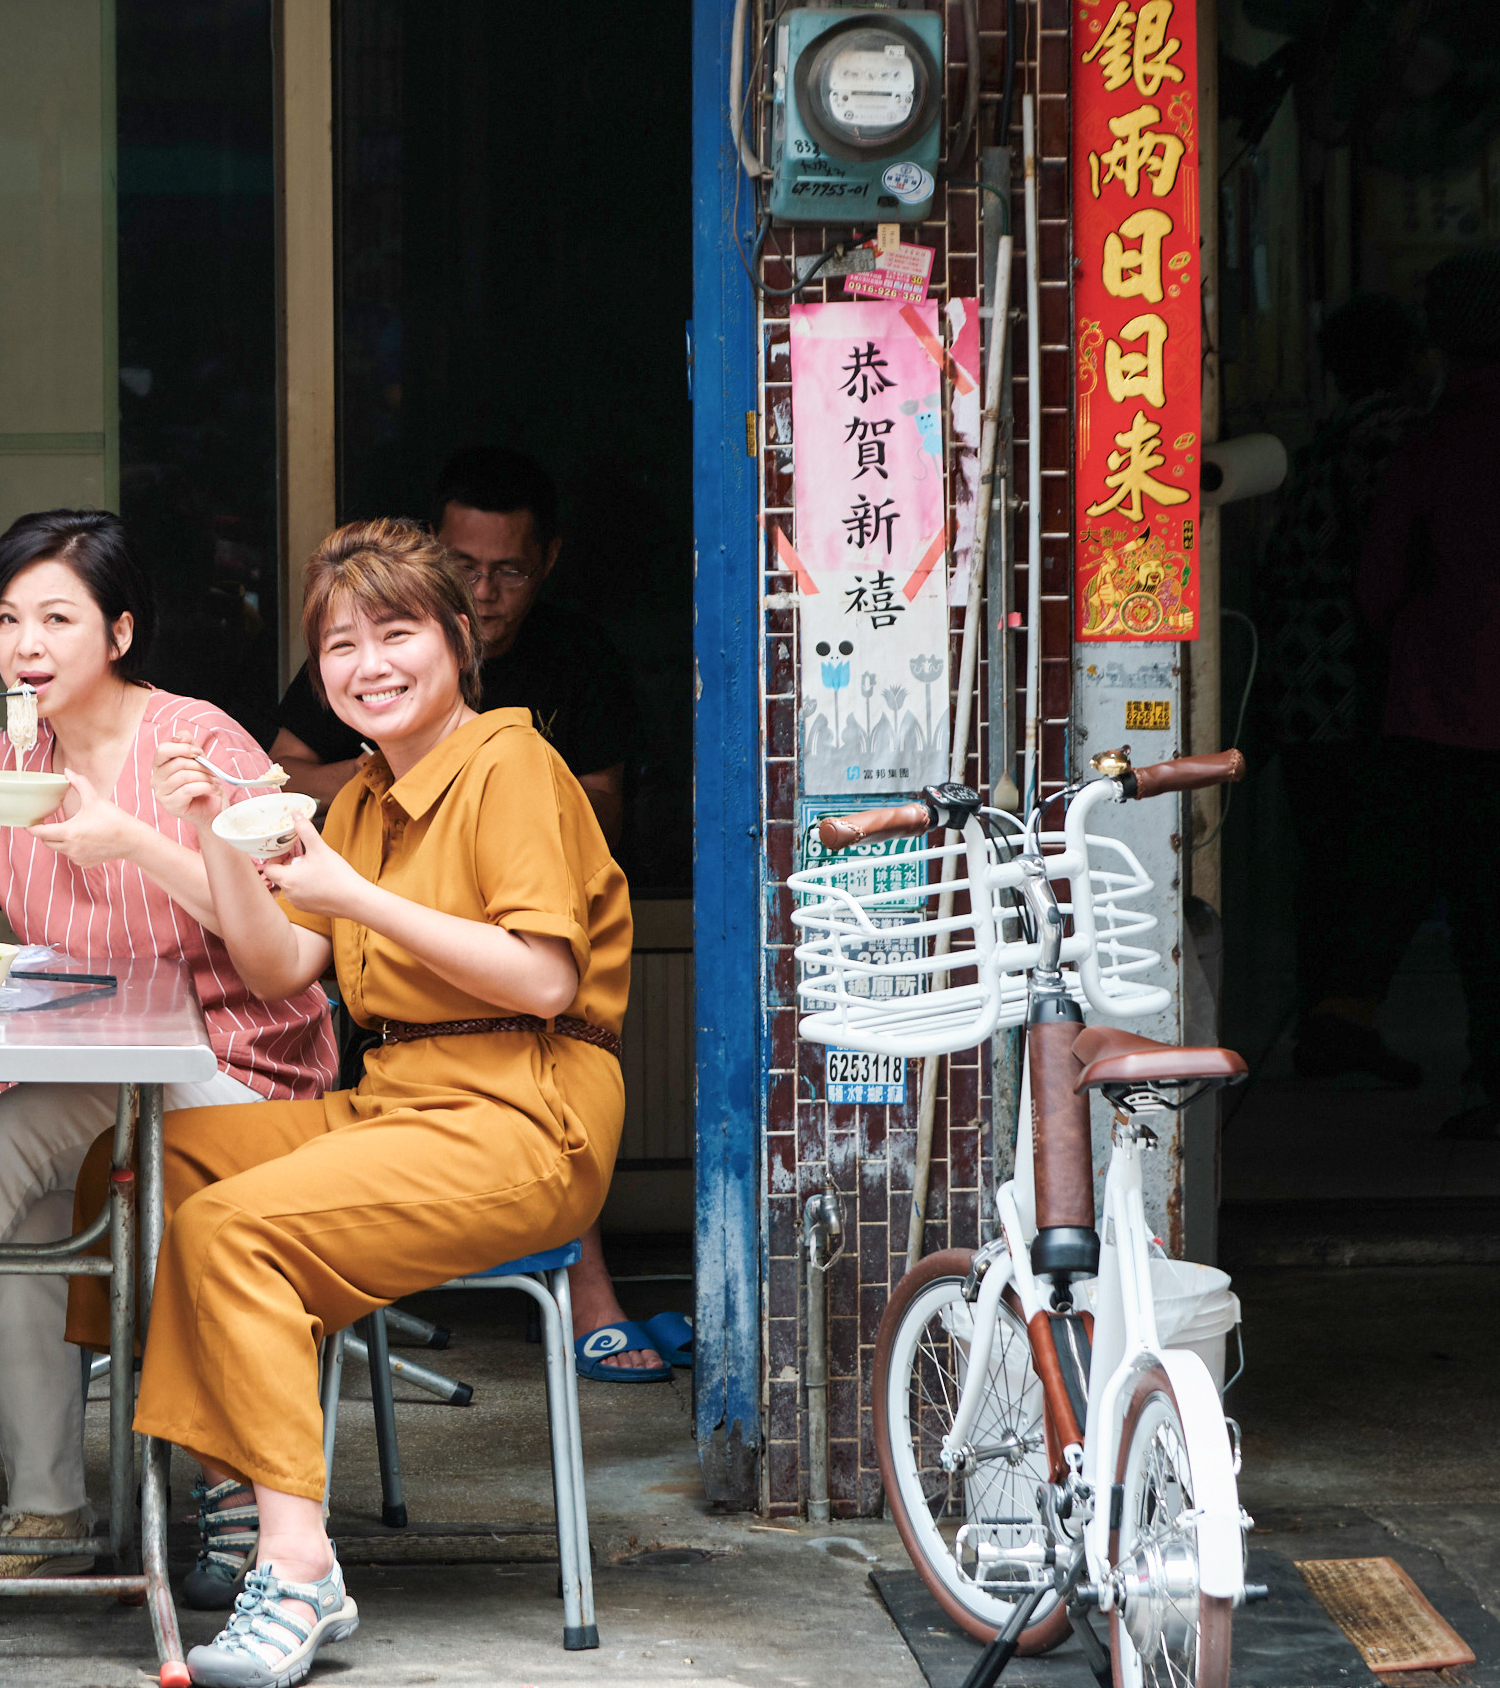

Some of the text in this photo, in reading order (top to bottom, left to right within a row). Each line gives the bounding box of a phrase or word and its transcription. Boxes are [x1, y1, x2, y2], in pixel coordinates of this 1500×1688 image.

[838, 341, 905, 629] 恭賀新禧
[863, 768, 910, 780] 富邦集團
[829, 1053, 902, 1083] 6253118
